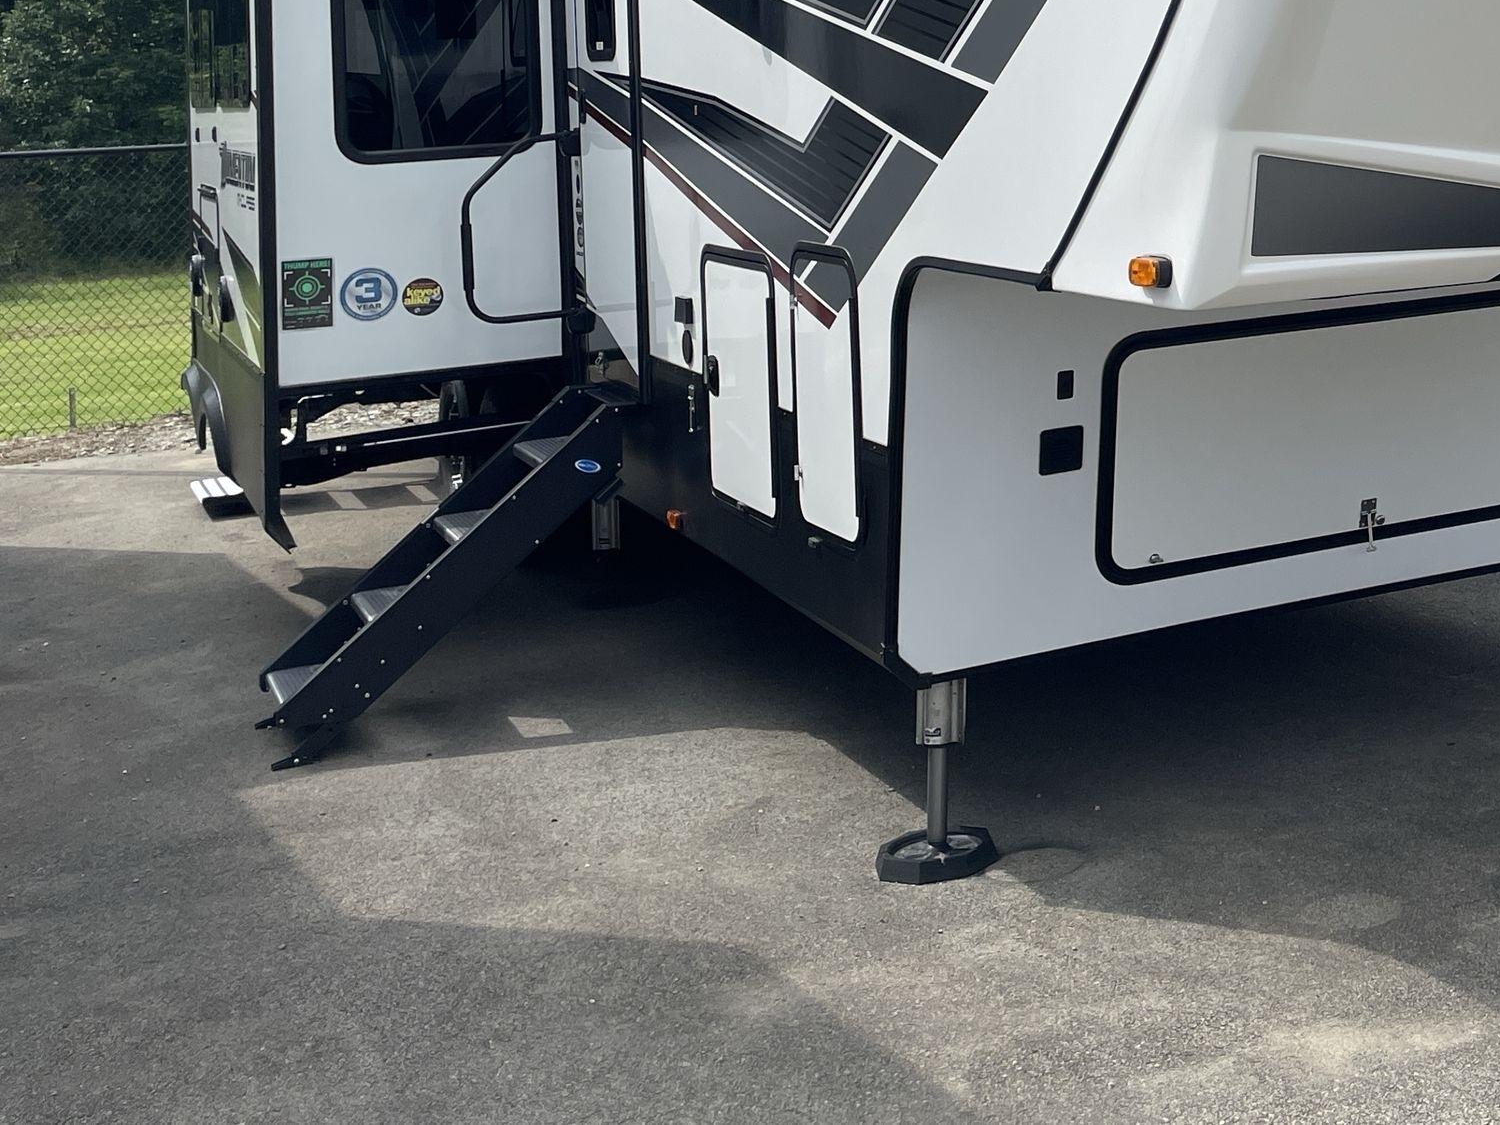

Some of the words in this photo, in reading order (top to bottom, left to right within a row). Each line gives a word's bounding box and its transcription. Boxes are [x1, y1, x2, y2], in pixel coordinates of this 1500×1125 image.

[355, 277, 382, 304] 3
[406, 286, 441, 298] keyed
[356, 302, 382, 311] YEAR
[404, 296, 431, 307] alike
